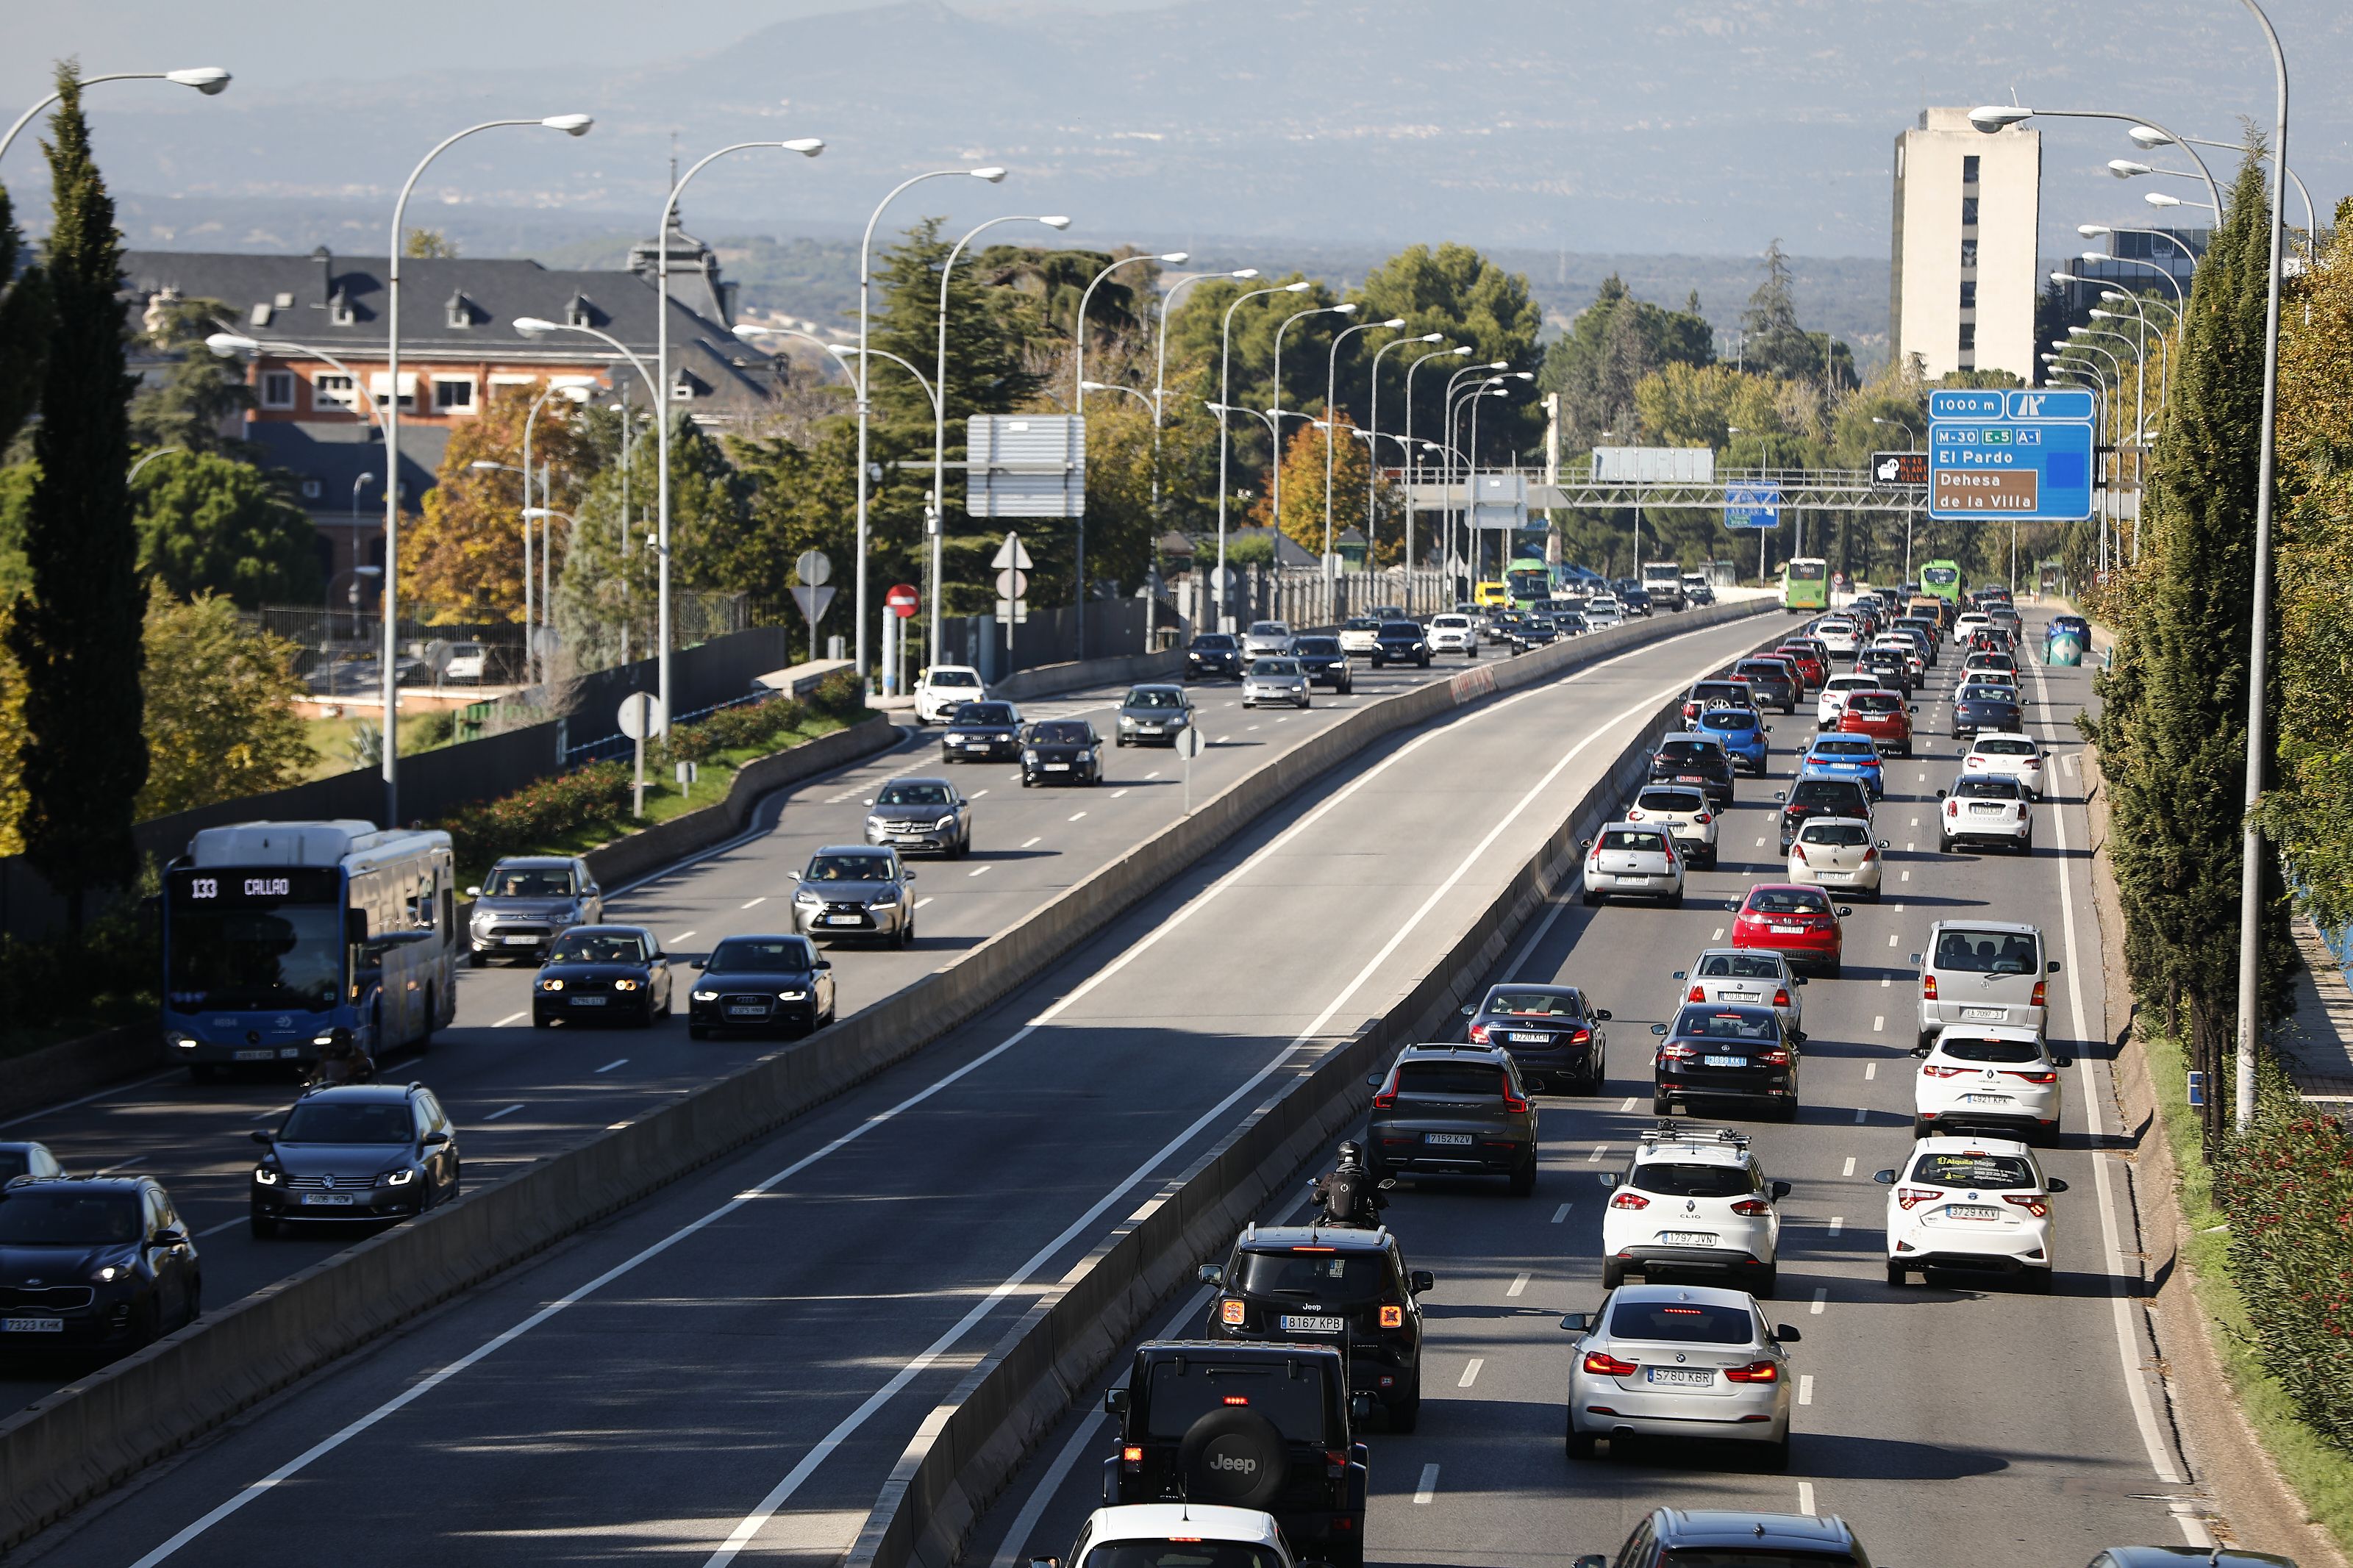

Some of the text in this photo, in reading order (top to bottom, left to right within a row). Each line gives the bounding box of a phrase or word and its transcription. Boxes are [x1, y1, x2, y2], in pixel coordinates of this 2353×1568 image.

[1939, 399, 1995, 410] 1000 m
[1939, 431, 2040, 443] M-30 E-5 A-1
[1939, 450, 2013, 464] El Pardo
[1940, 473, 2000, 486] Dehesa
[1940, 494, 2031, 508] de la Villa
[192, 878, 218, 898] 133
[244, 878, 289, 895] CALLAO
[1710, 1056, 1729, 1064] 3699
[1972, 1095, 1990, 1103] 4921
[1431, 1135, 1471, 1144] 7152 KZV
[1952, 1207, 1996, 1217] 3729 KKV
[1671, 1234, 1713, 1243] 1797 JVN
[1302, 1303, 1321, 1311] Jeep
[9, 1320, 60, 1331] 7323 KHK
[1289, 1317, 1340, 1329] 8167 KPB
[1656, 1370, 1710, 1383] 5780 KBR
[1210, 1453, 1256, 1475] Jeep
